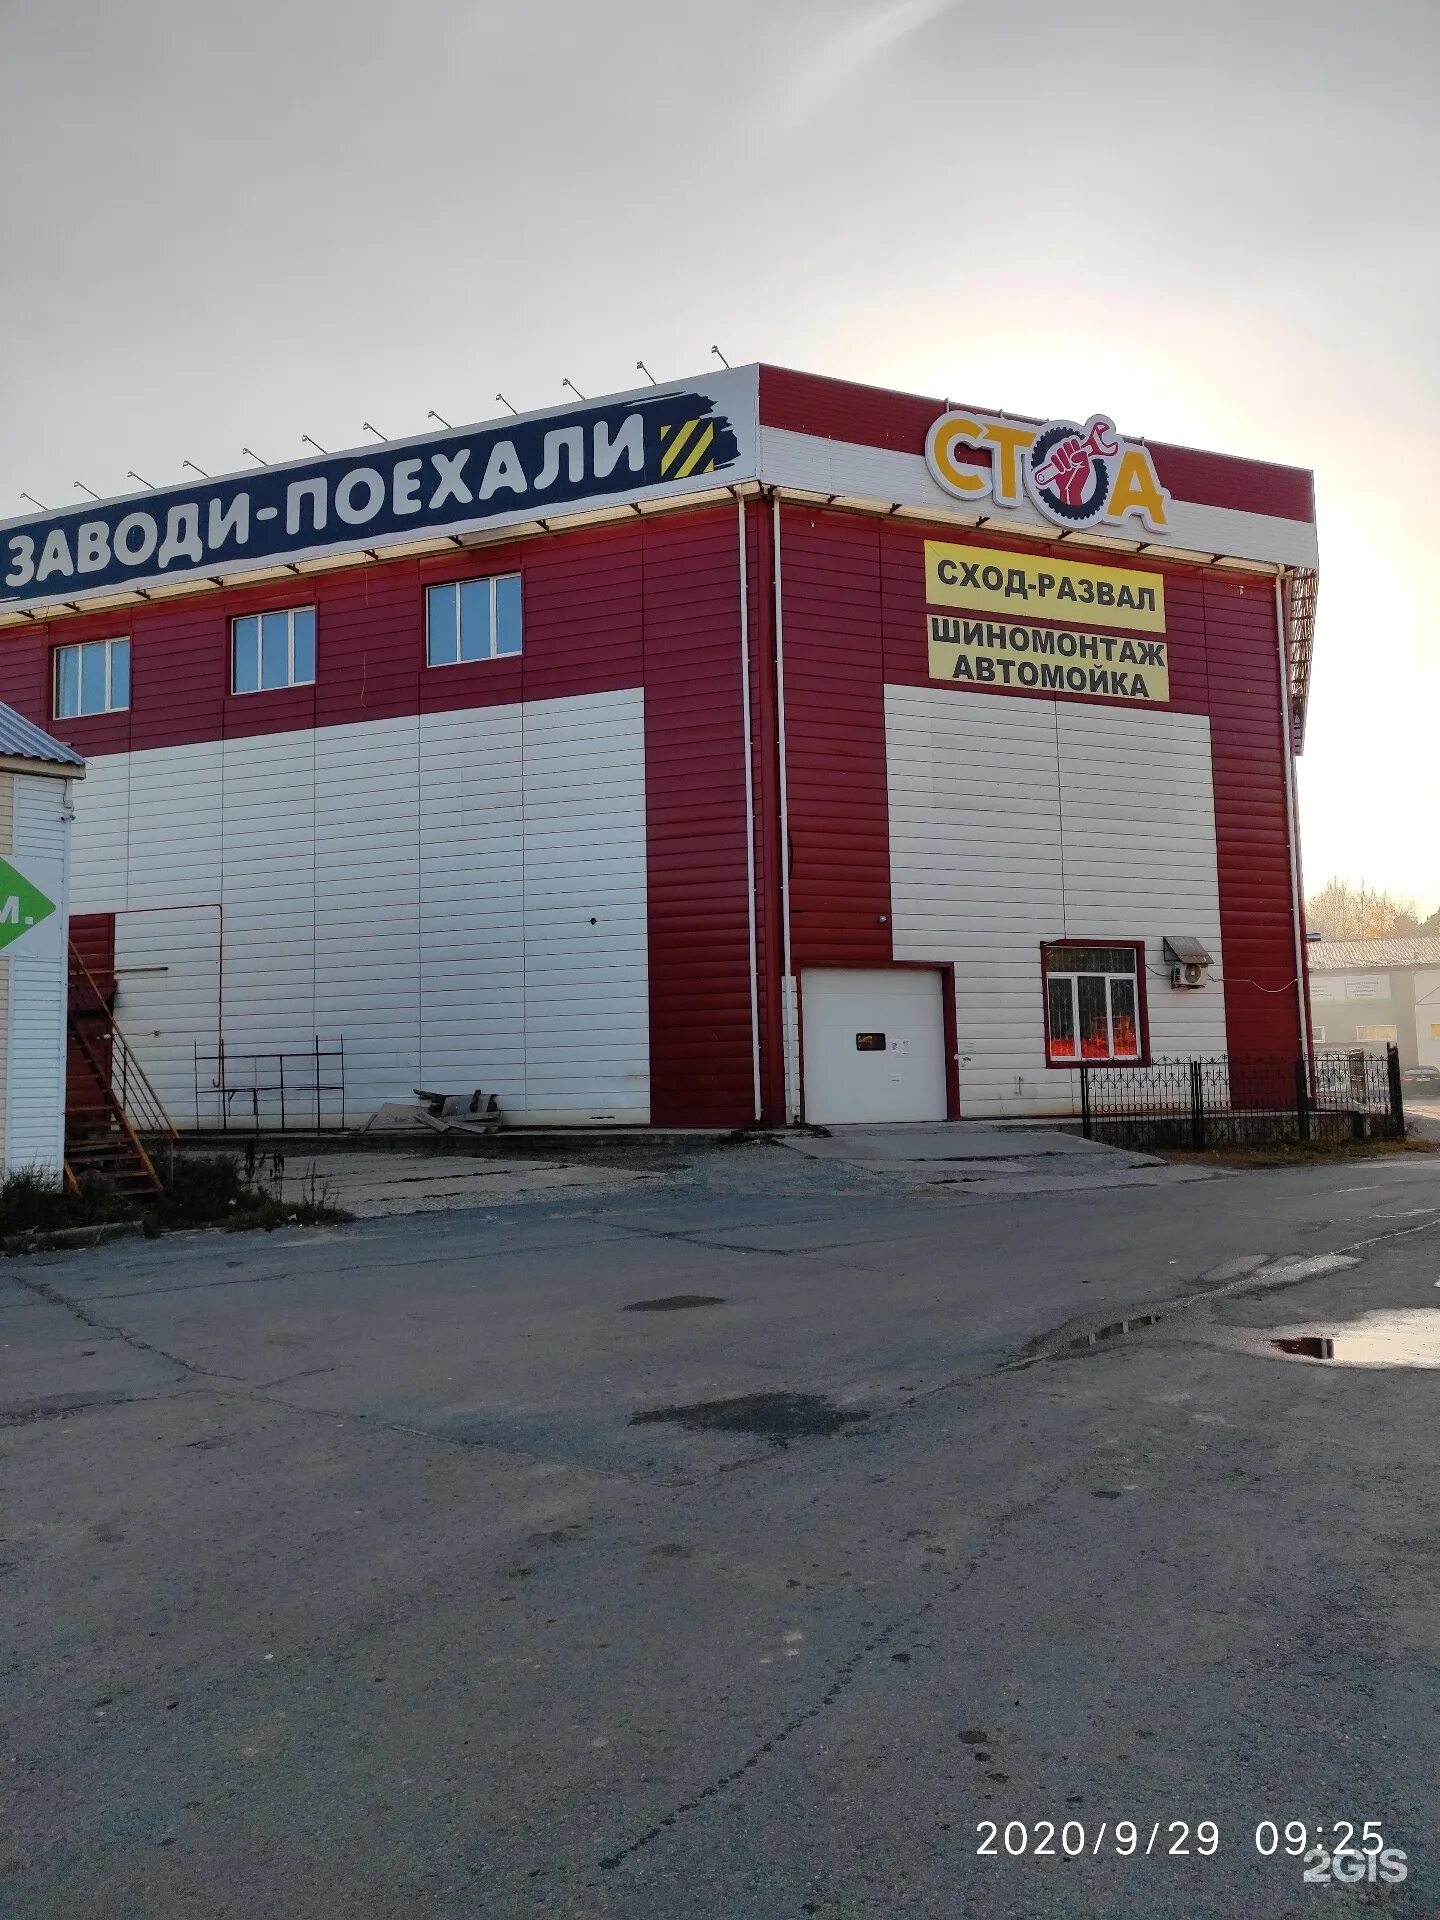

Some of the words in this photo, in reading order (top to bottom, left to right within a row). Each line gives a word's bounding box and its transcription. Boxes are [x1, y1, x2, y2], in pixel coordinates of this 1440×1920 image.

[5, 413, 645, 588] ЗАВОДИ-ПОЕХАЛИ
[936, 559, 1156, 612] СХОД-РАЗВАЛ
[931, 617, 1165, 667] ШИНОМОНТАЖ
[952, 654, 1150, 698] АВТОМОЙКА
